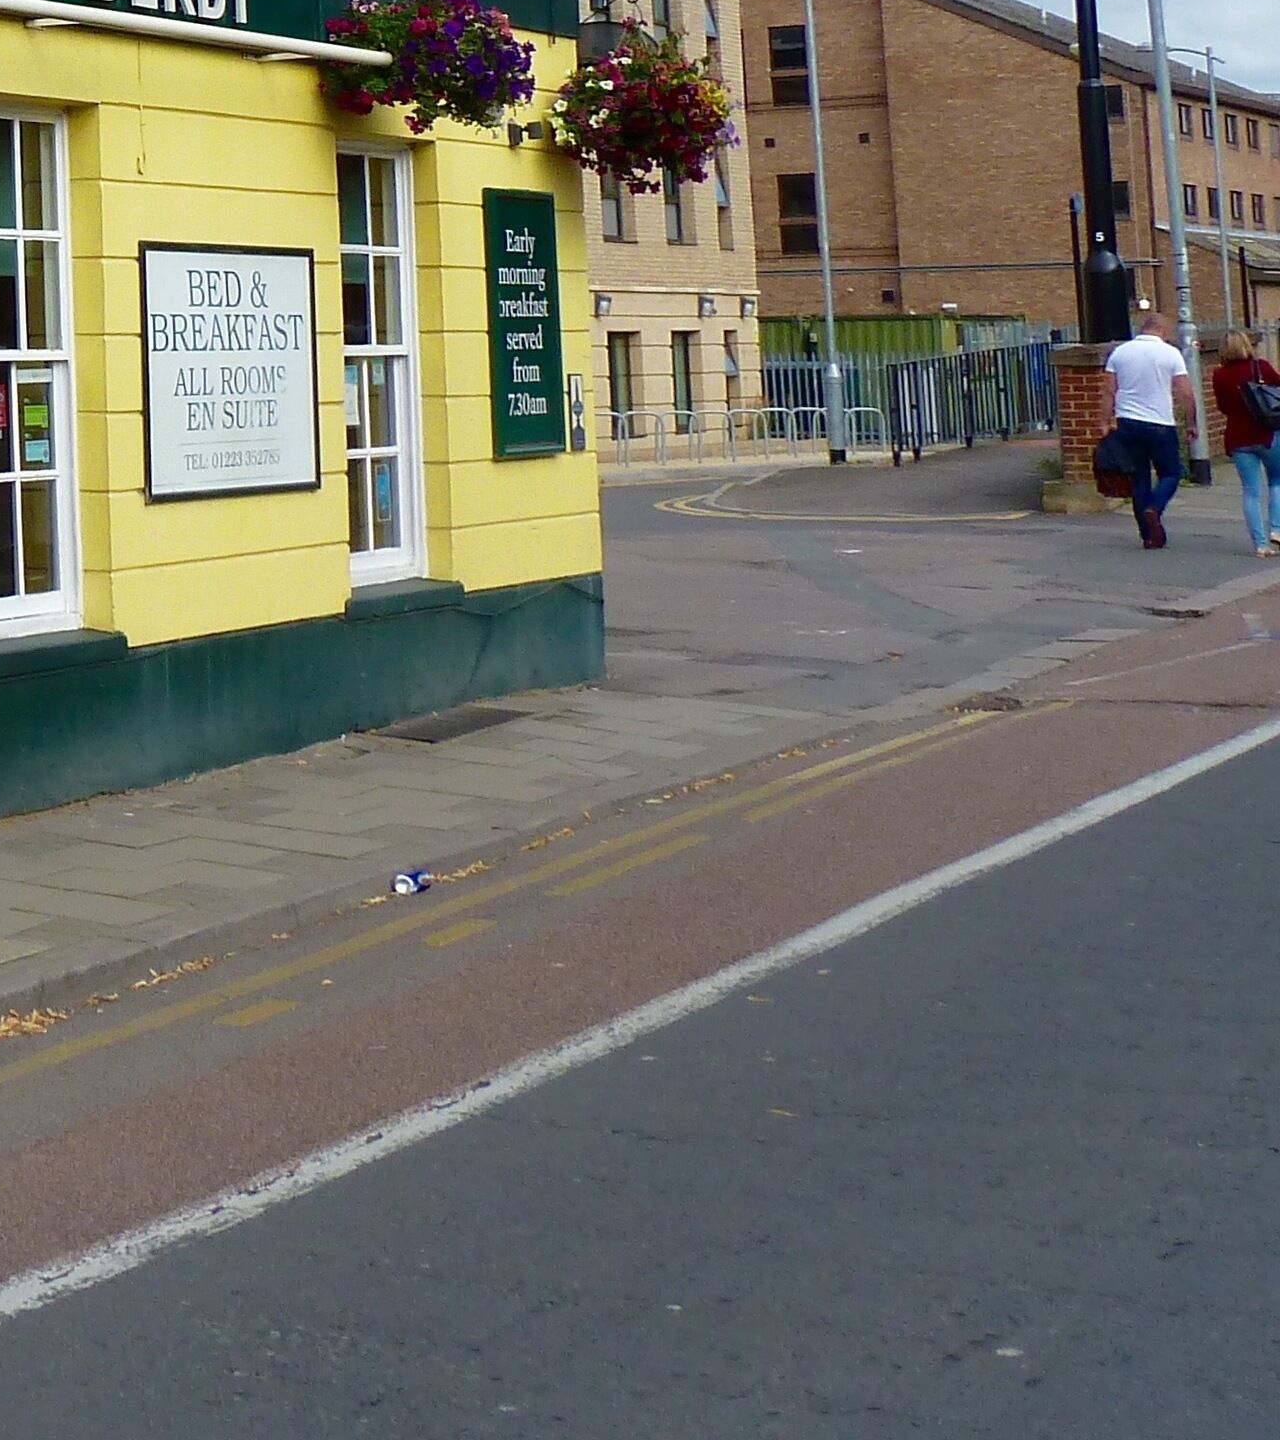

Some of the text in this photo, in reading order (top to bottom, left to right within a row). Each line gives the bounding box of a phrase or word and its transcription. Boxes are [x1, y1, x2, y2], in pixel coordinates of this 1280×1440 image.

[505, 227, 536, 259] Early
[1095, 231, 1105, 242] 5
[186, 269, 268, 308] BED &
[498, 261, 546, 291] morning
[151, 313, 304, 352] BREAKFAST
[506, 324, 544, 350] served
[174, 365, 286, 396] ALL ROOMS
[513, 356, 541, 382] from
[186, 400, 278, 431] EN SUITE
[508, 392, 547, 416] 7.30am
